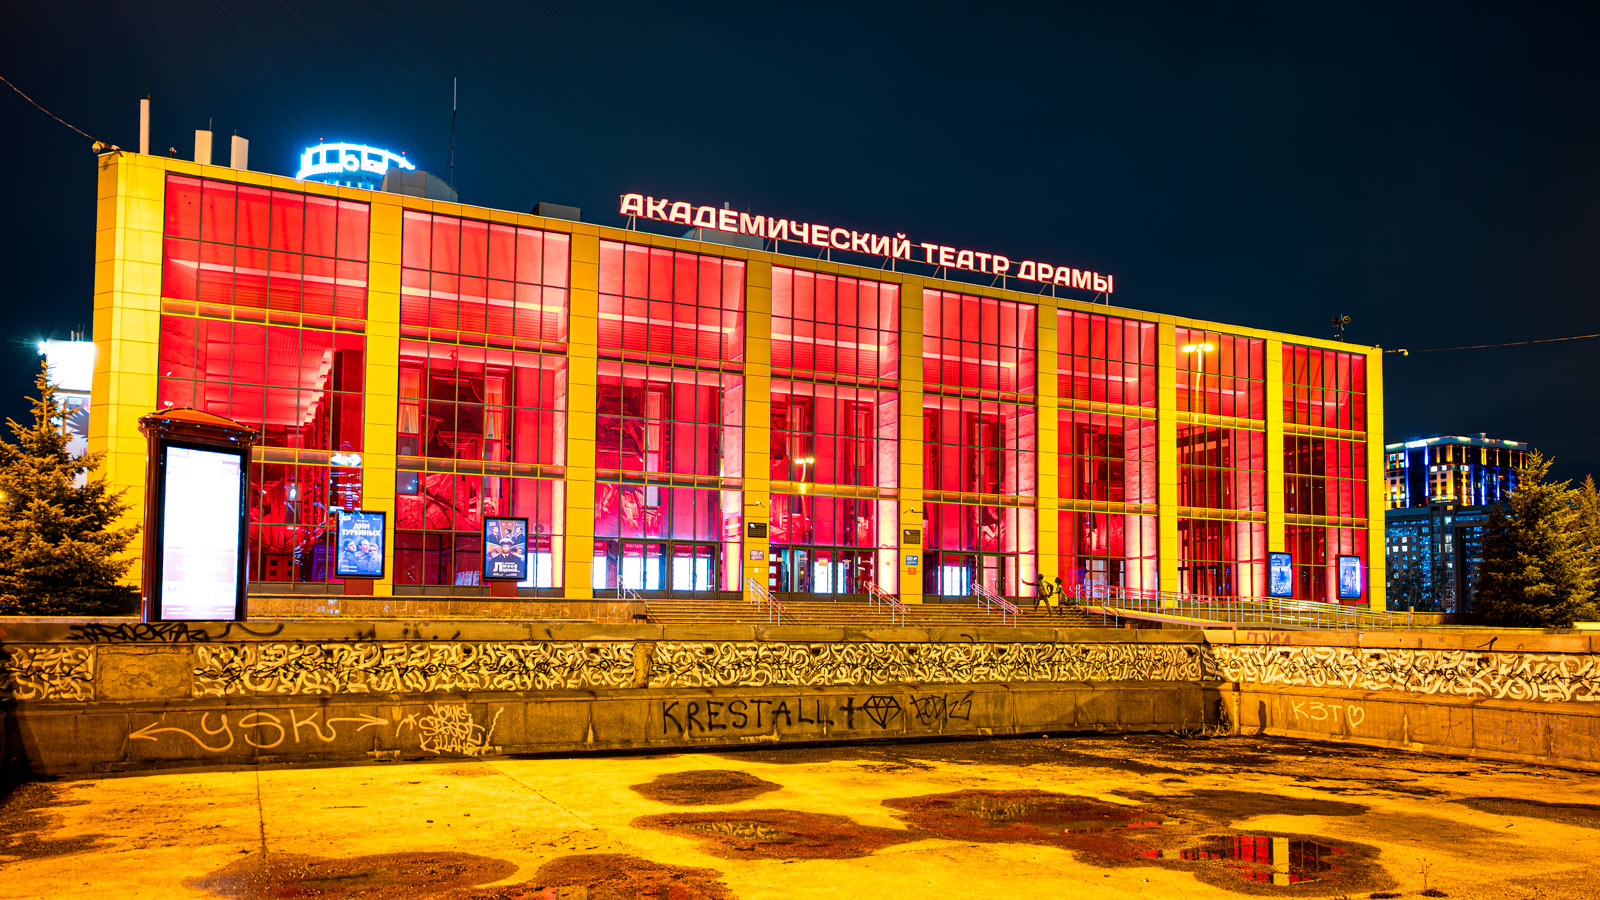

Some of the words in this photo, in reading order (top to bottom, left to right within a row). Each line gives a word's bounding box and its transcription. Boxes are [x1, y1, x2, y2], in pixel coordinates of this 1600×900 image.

[620, 193, 911, 260] АКАДЕМИЧЕСКИЙ
[920, 242, 1010, 275] ТЕАТР
[1017, 260, 1114, 293] ДРАМЫ
[662, 697, 835, 734] KRESTALL
